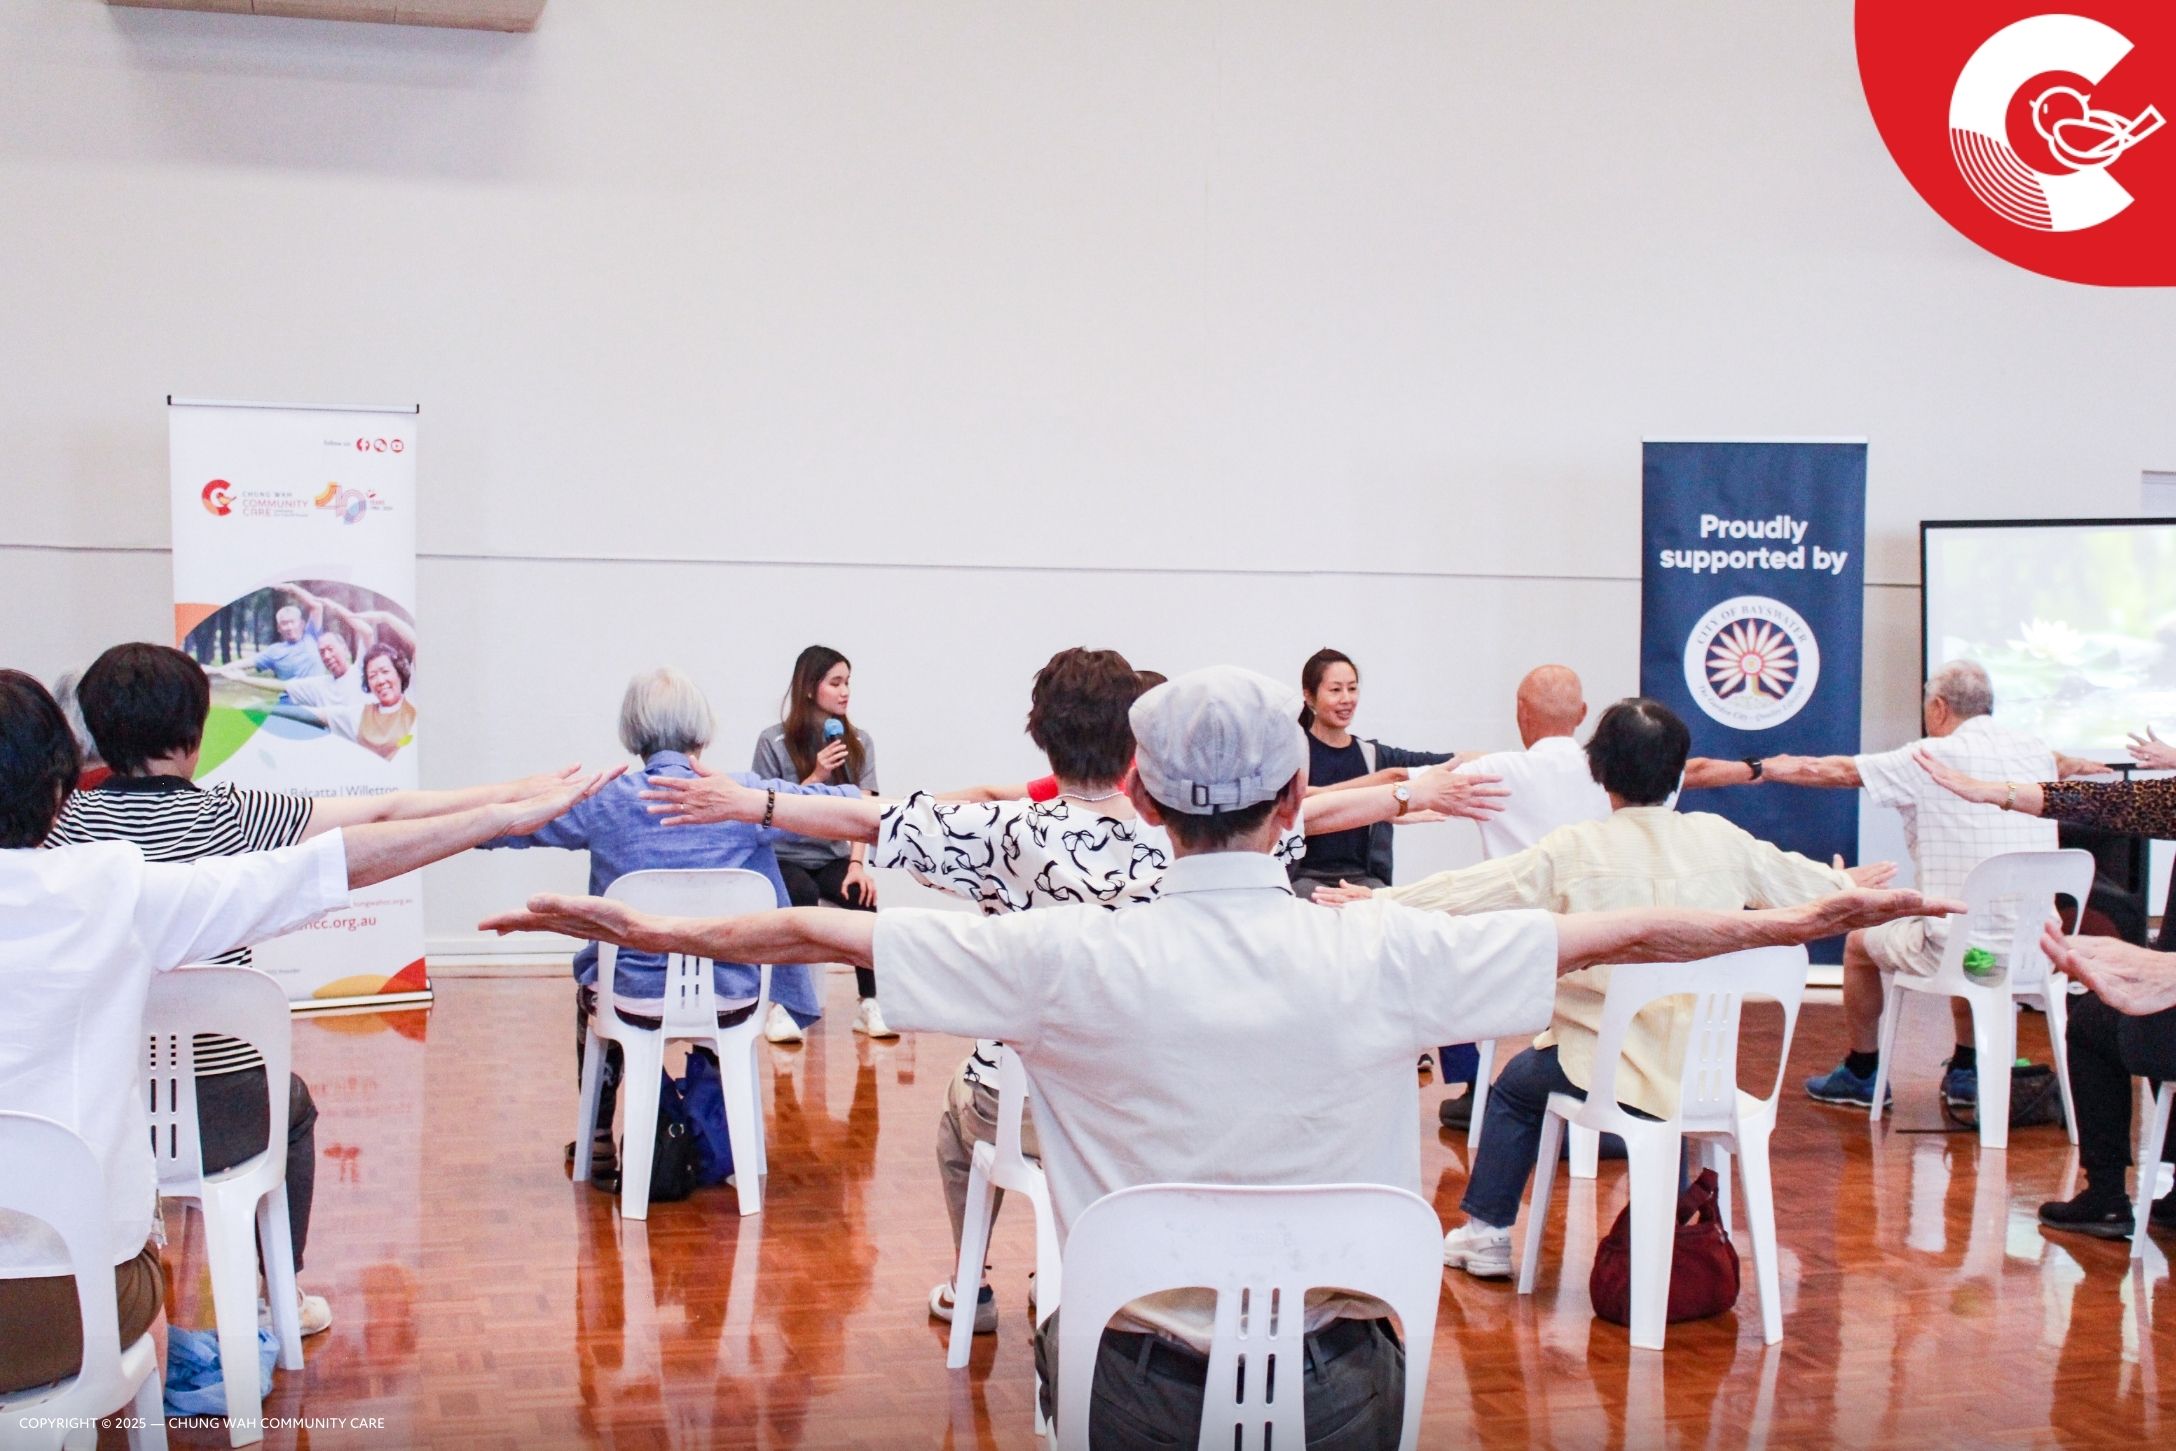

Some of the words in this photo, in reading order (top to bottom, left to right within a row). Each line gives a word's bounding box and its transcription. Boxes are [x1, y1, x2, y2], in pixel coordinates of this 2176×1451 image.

[242, 499, 308, 508] COMMUNITY
[242, 508, 272, 516] CARE
[1700, 514, 1808, 545] Proudly
[1659, 546, 1805, 574] supported
[1812, 546, 1848, 575] by
[1697, 619, 1719, 645] CITY
[1721, 607, 1737, 619] OF
[1741, 605, 1808, 643] BAYSWATER
